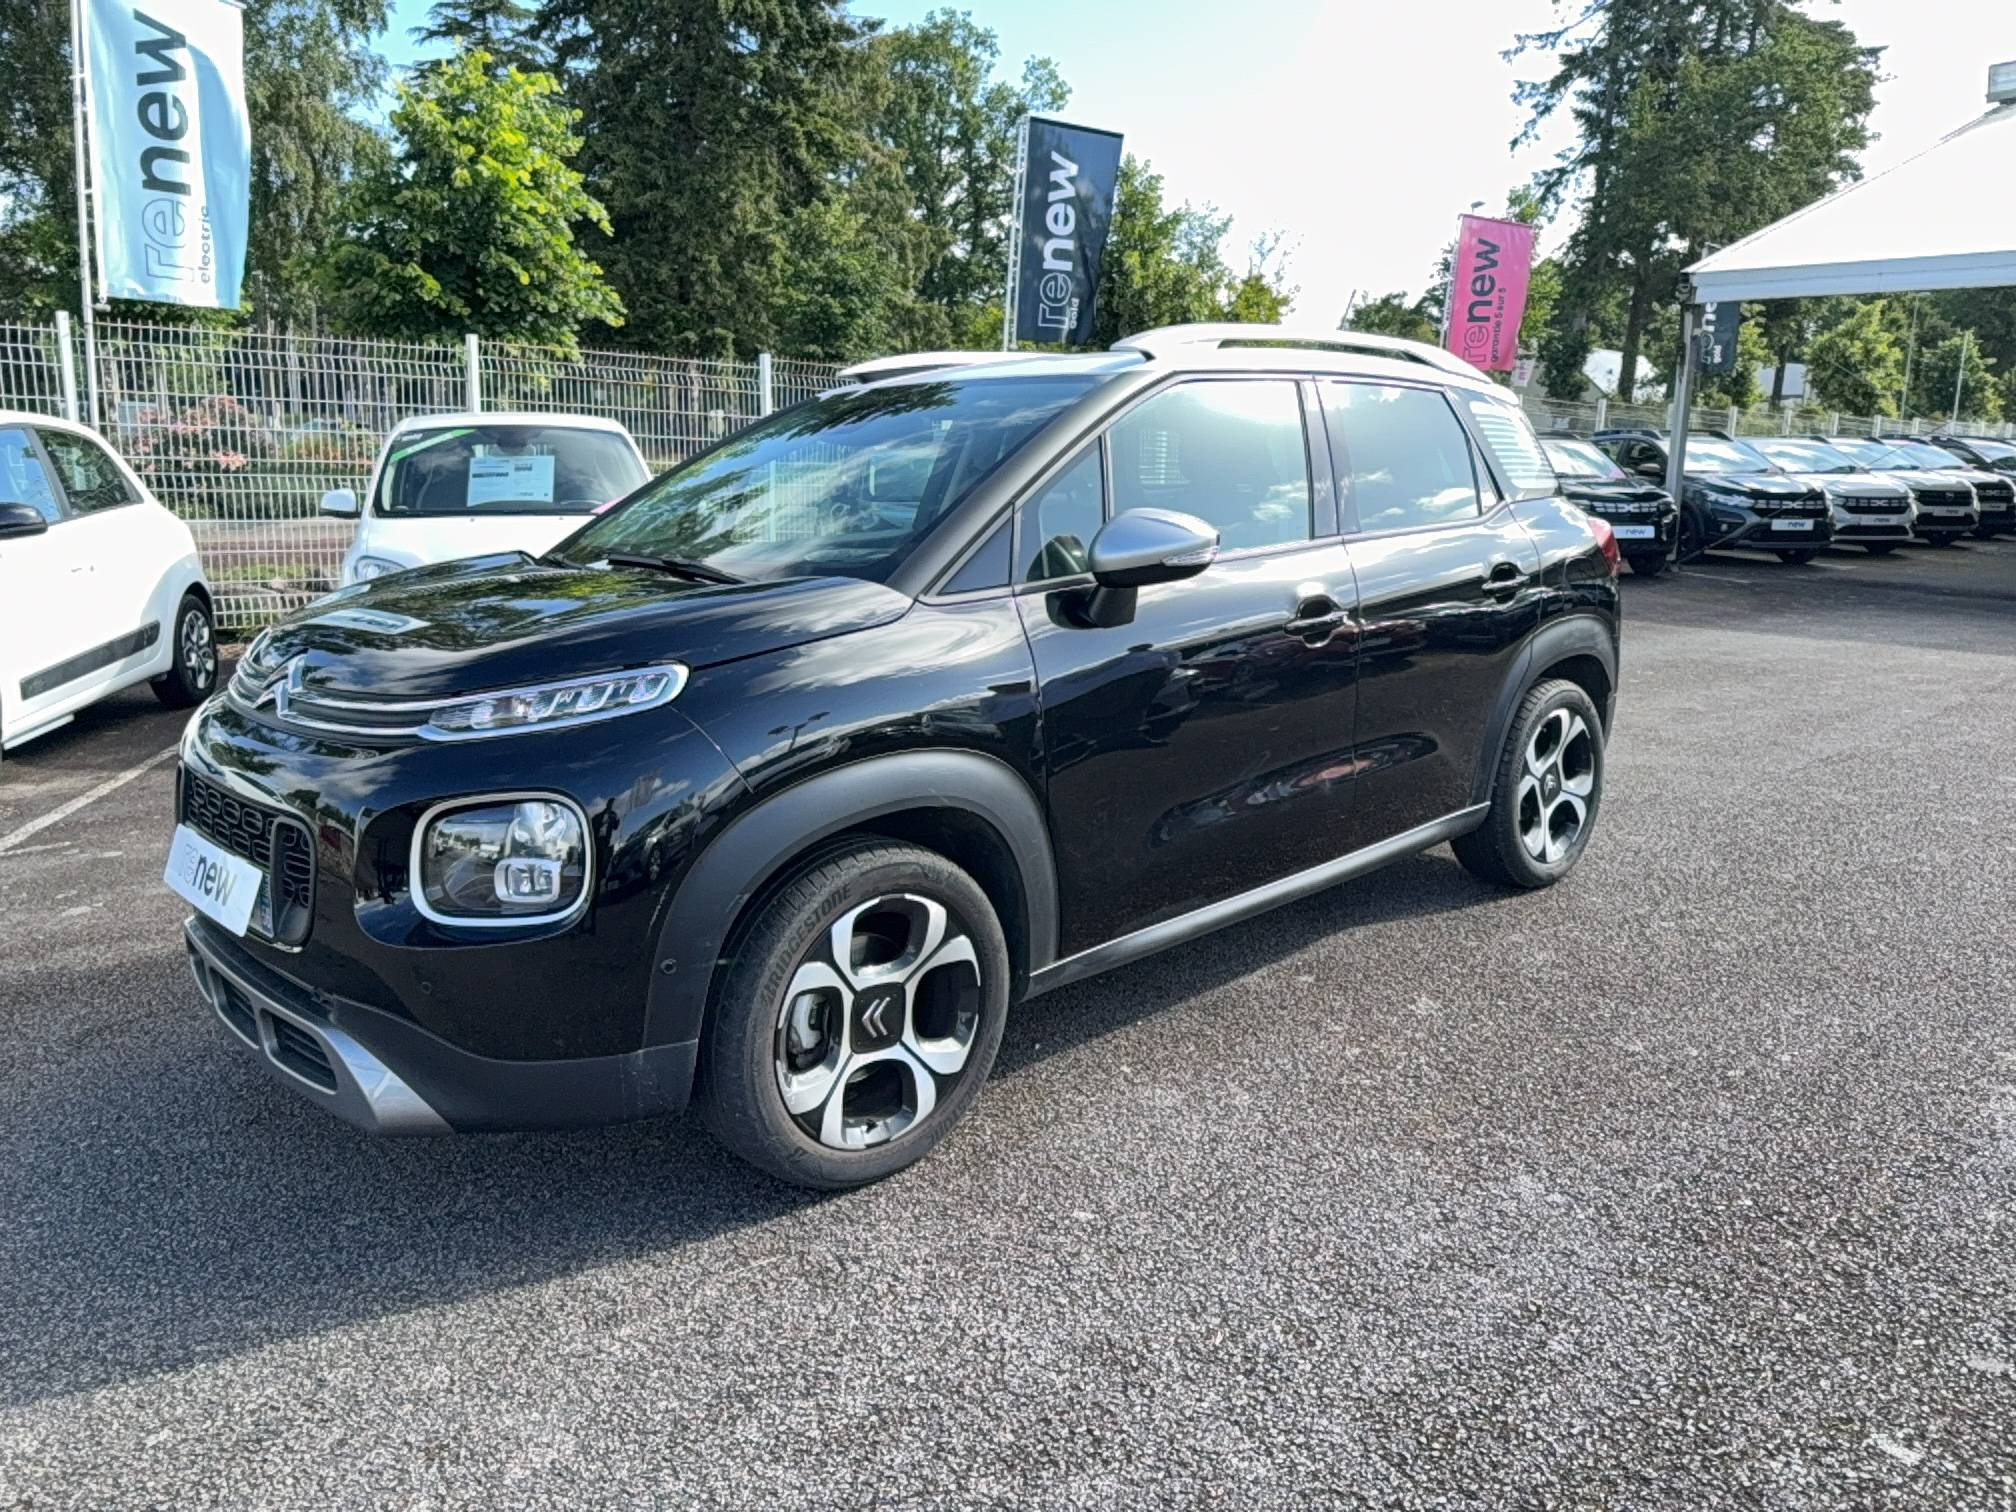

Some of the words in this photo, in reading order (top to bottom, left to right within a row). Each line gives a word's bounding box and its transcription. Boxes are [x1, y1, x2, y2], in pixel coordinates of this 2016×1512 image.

[133, 8, 194, 281] renew
[198, 205, 210, 284] electric
[1038, 150, 1080, 329] renew
[1462, 238, 1501, 363] renew
